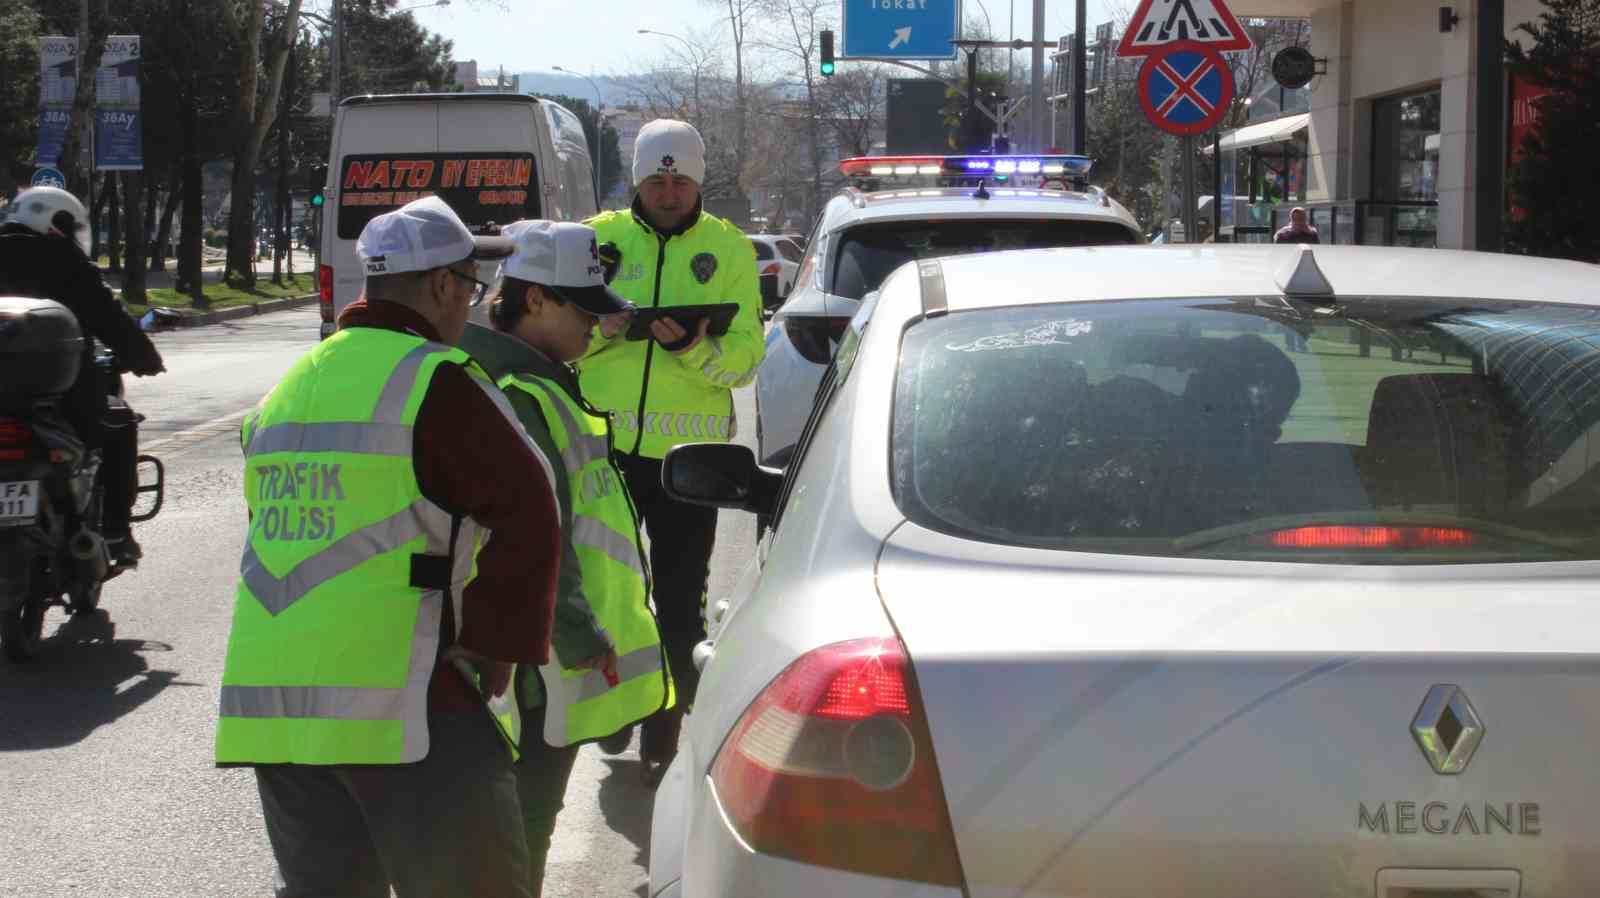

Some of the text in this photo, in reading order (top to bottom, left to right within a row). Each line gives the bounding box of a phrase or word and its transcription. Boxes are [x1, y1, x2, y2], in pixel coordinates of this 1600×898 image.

[129, 42, 139, 57] 2
[343, 159, 435, 189] NATO
[5, 484, 32, 498] FA
[1357, 800, 1542, 836] MEGANE
